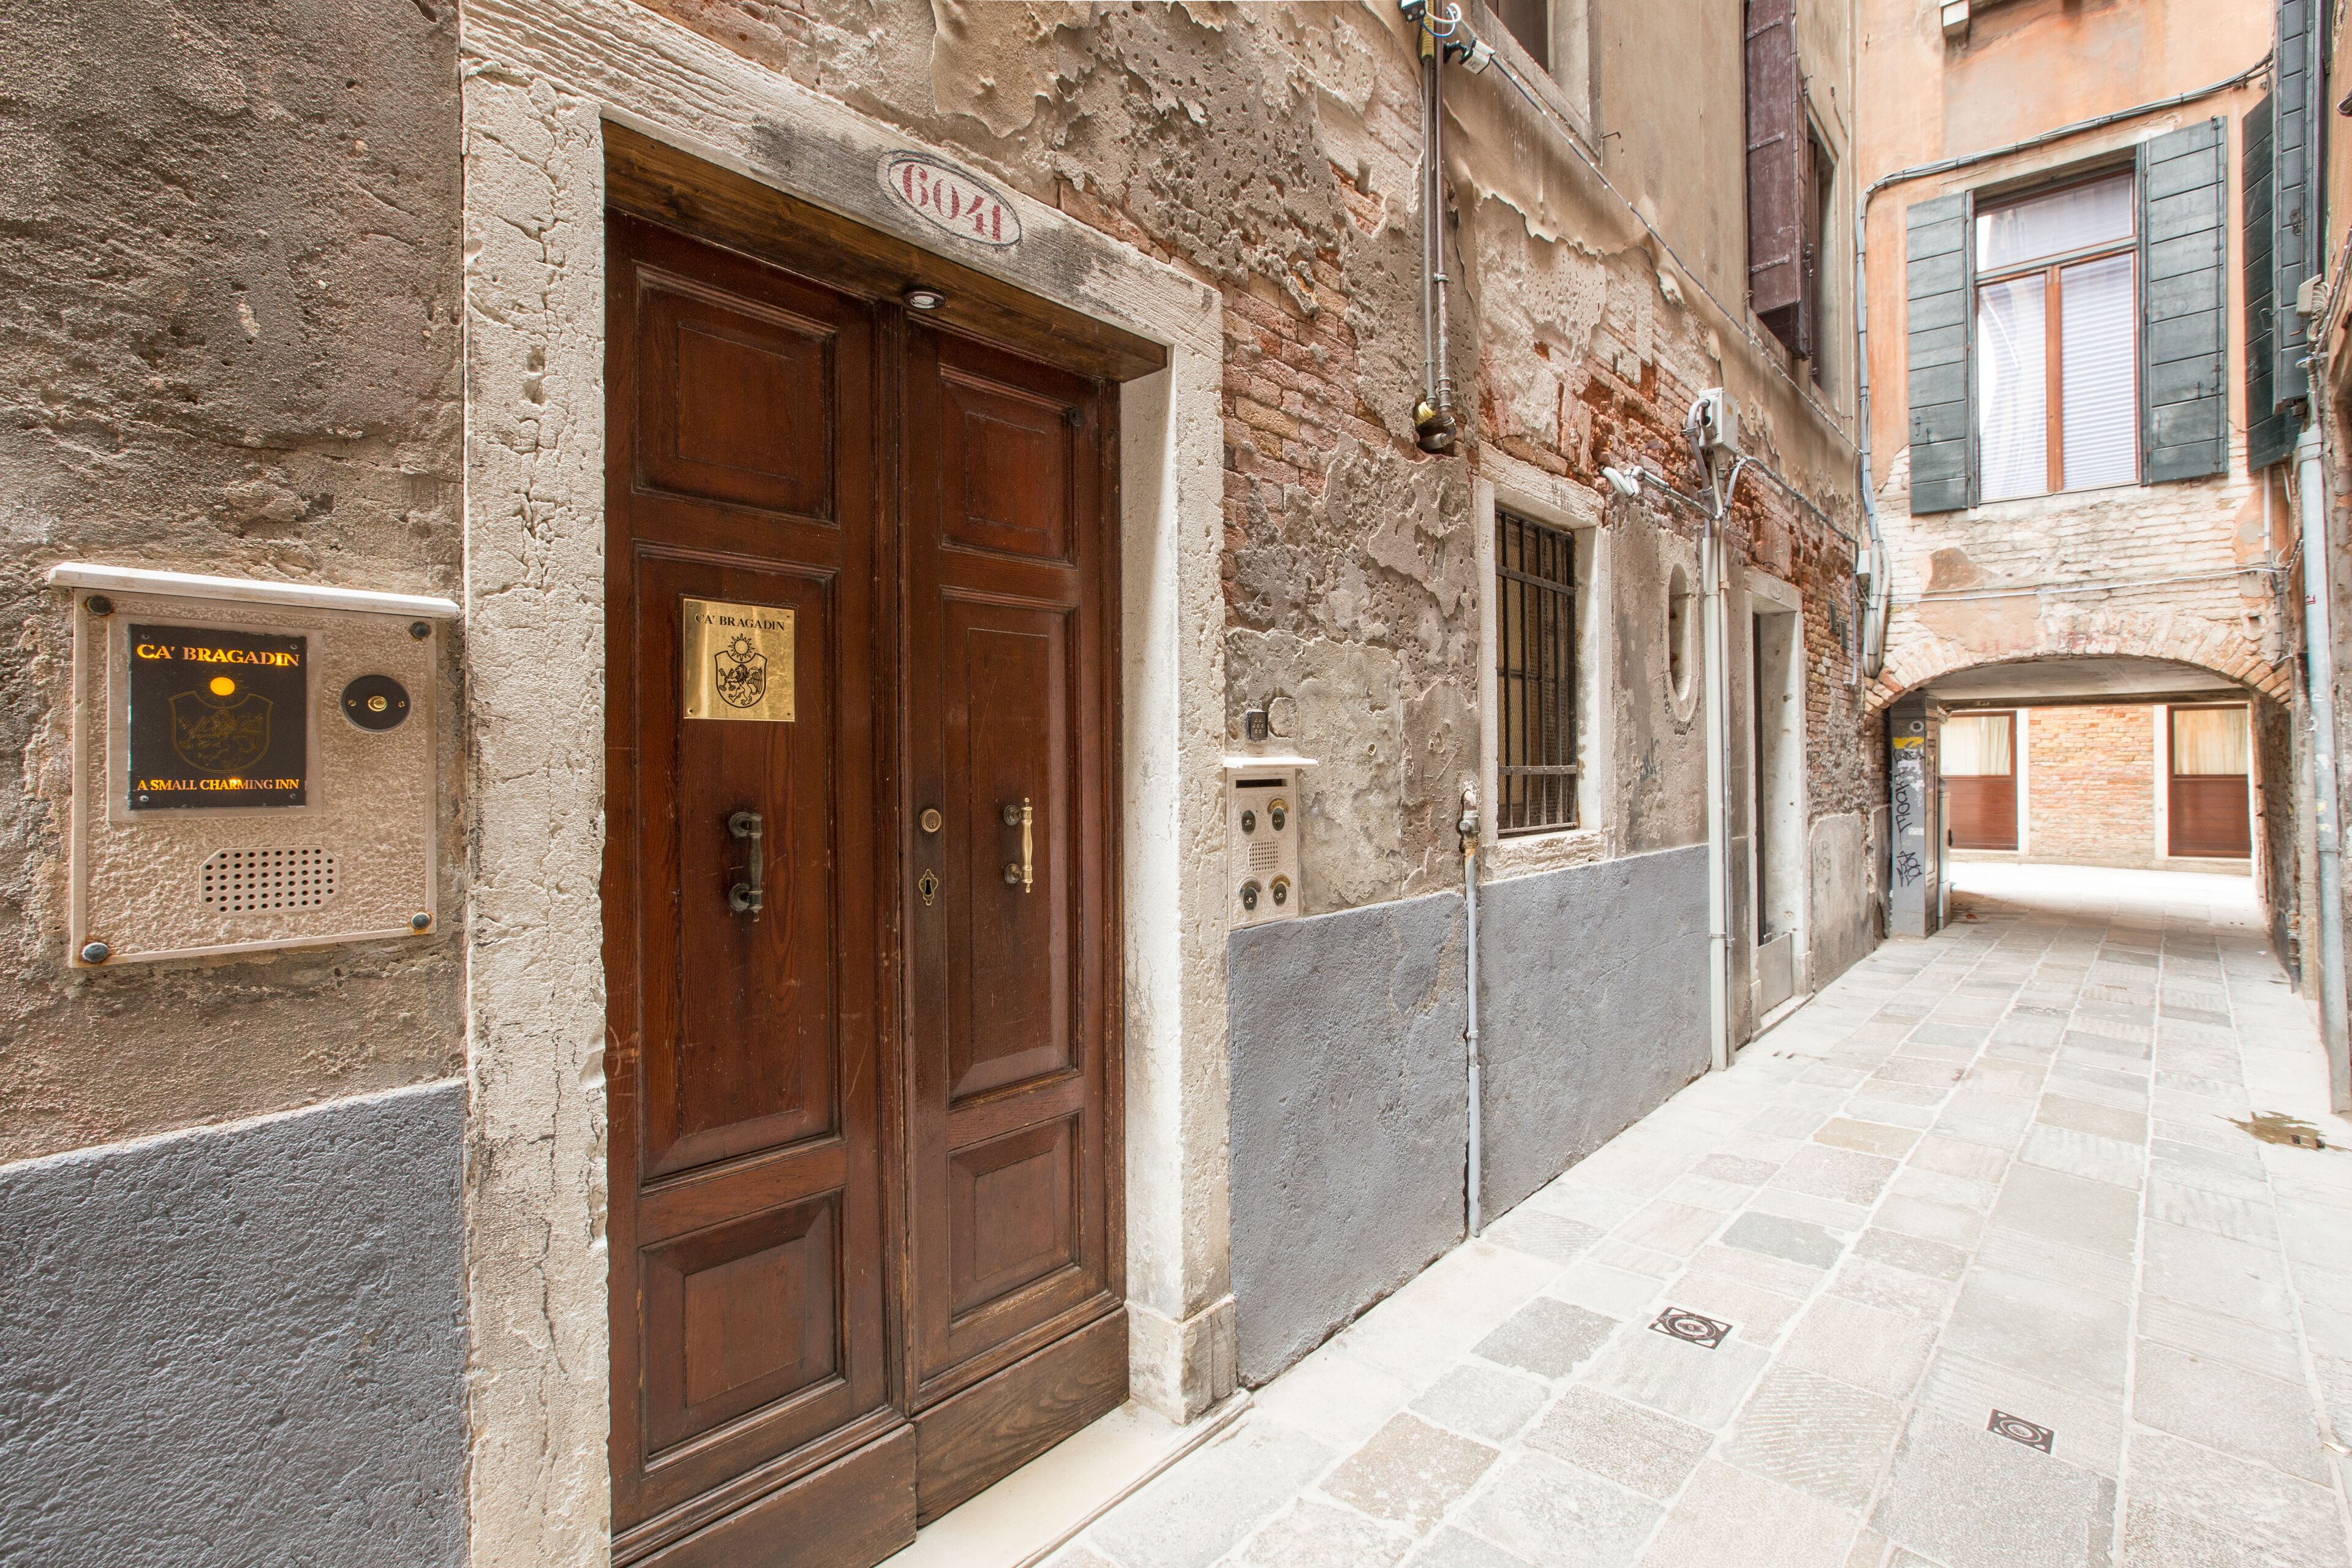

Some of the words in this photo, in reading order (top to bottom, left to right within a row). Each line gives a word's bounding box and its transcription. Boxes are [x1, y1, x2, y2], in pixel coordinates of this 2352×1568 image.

[902, 164, 1001, 242] 6041
[719, 616, 785, 630] BRAGADIN
[137, 644, 176, 660] CA'
[182, 647, 300, 666] BRAGADIN
[137, 779, 148, 790] A
[150, 779, 197, 791] SMALL
[199, 778, 273, 791] CHARMING
[275, 778, 300, 790] INN
